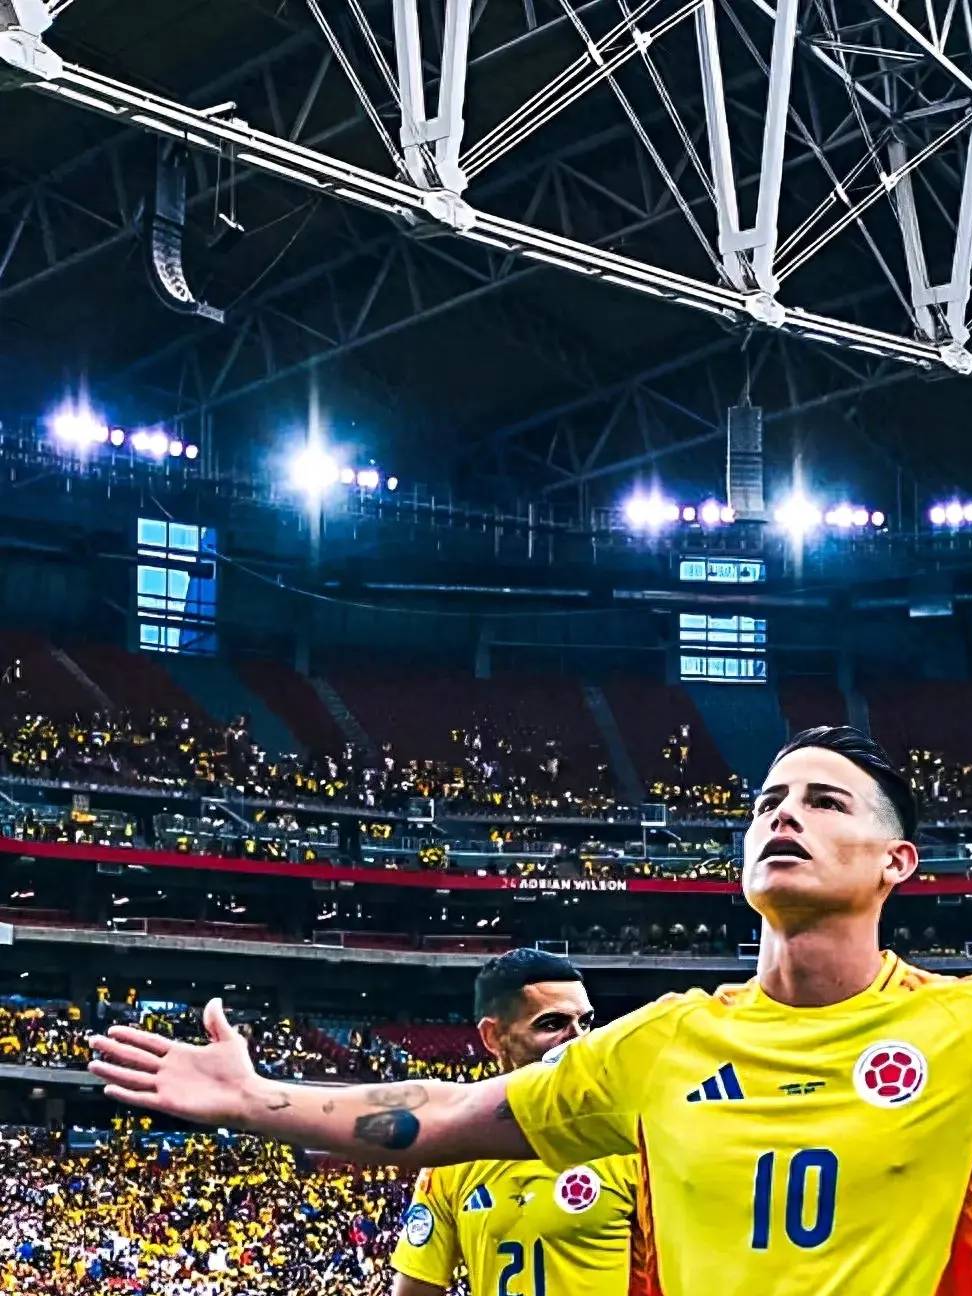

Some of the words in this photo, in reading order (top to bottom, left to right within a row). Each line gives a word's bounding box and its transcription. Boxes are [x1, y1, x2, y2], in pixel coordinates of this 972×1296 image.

[519, 878, 571, 890] ADRIAN
[572, 879, 627, 891] WILSON
[751, 1147, 839, 1250] 10
